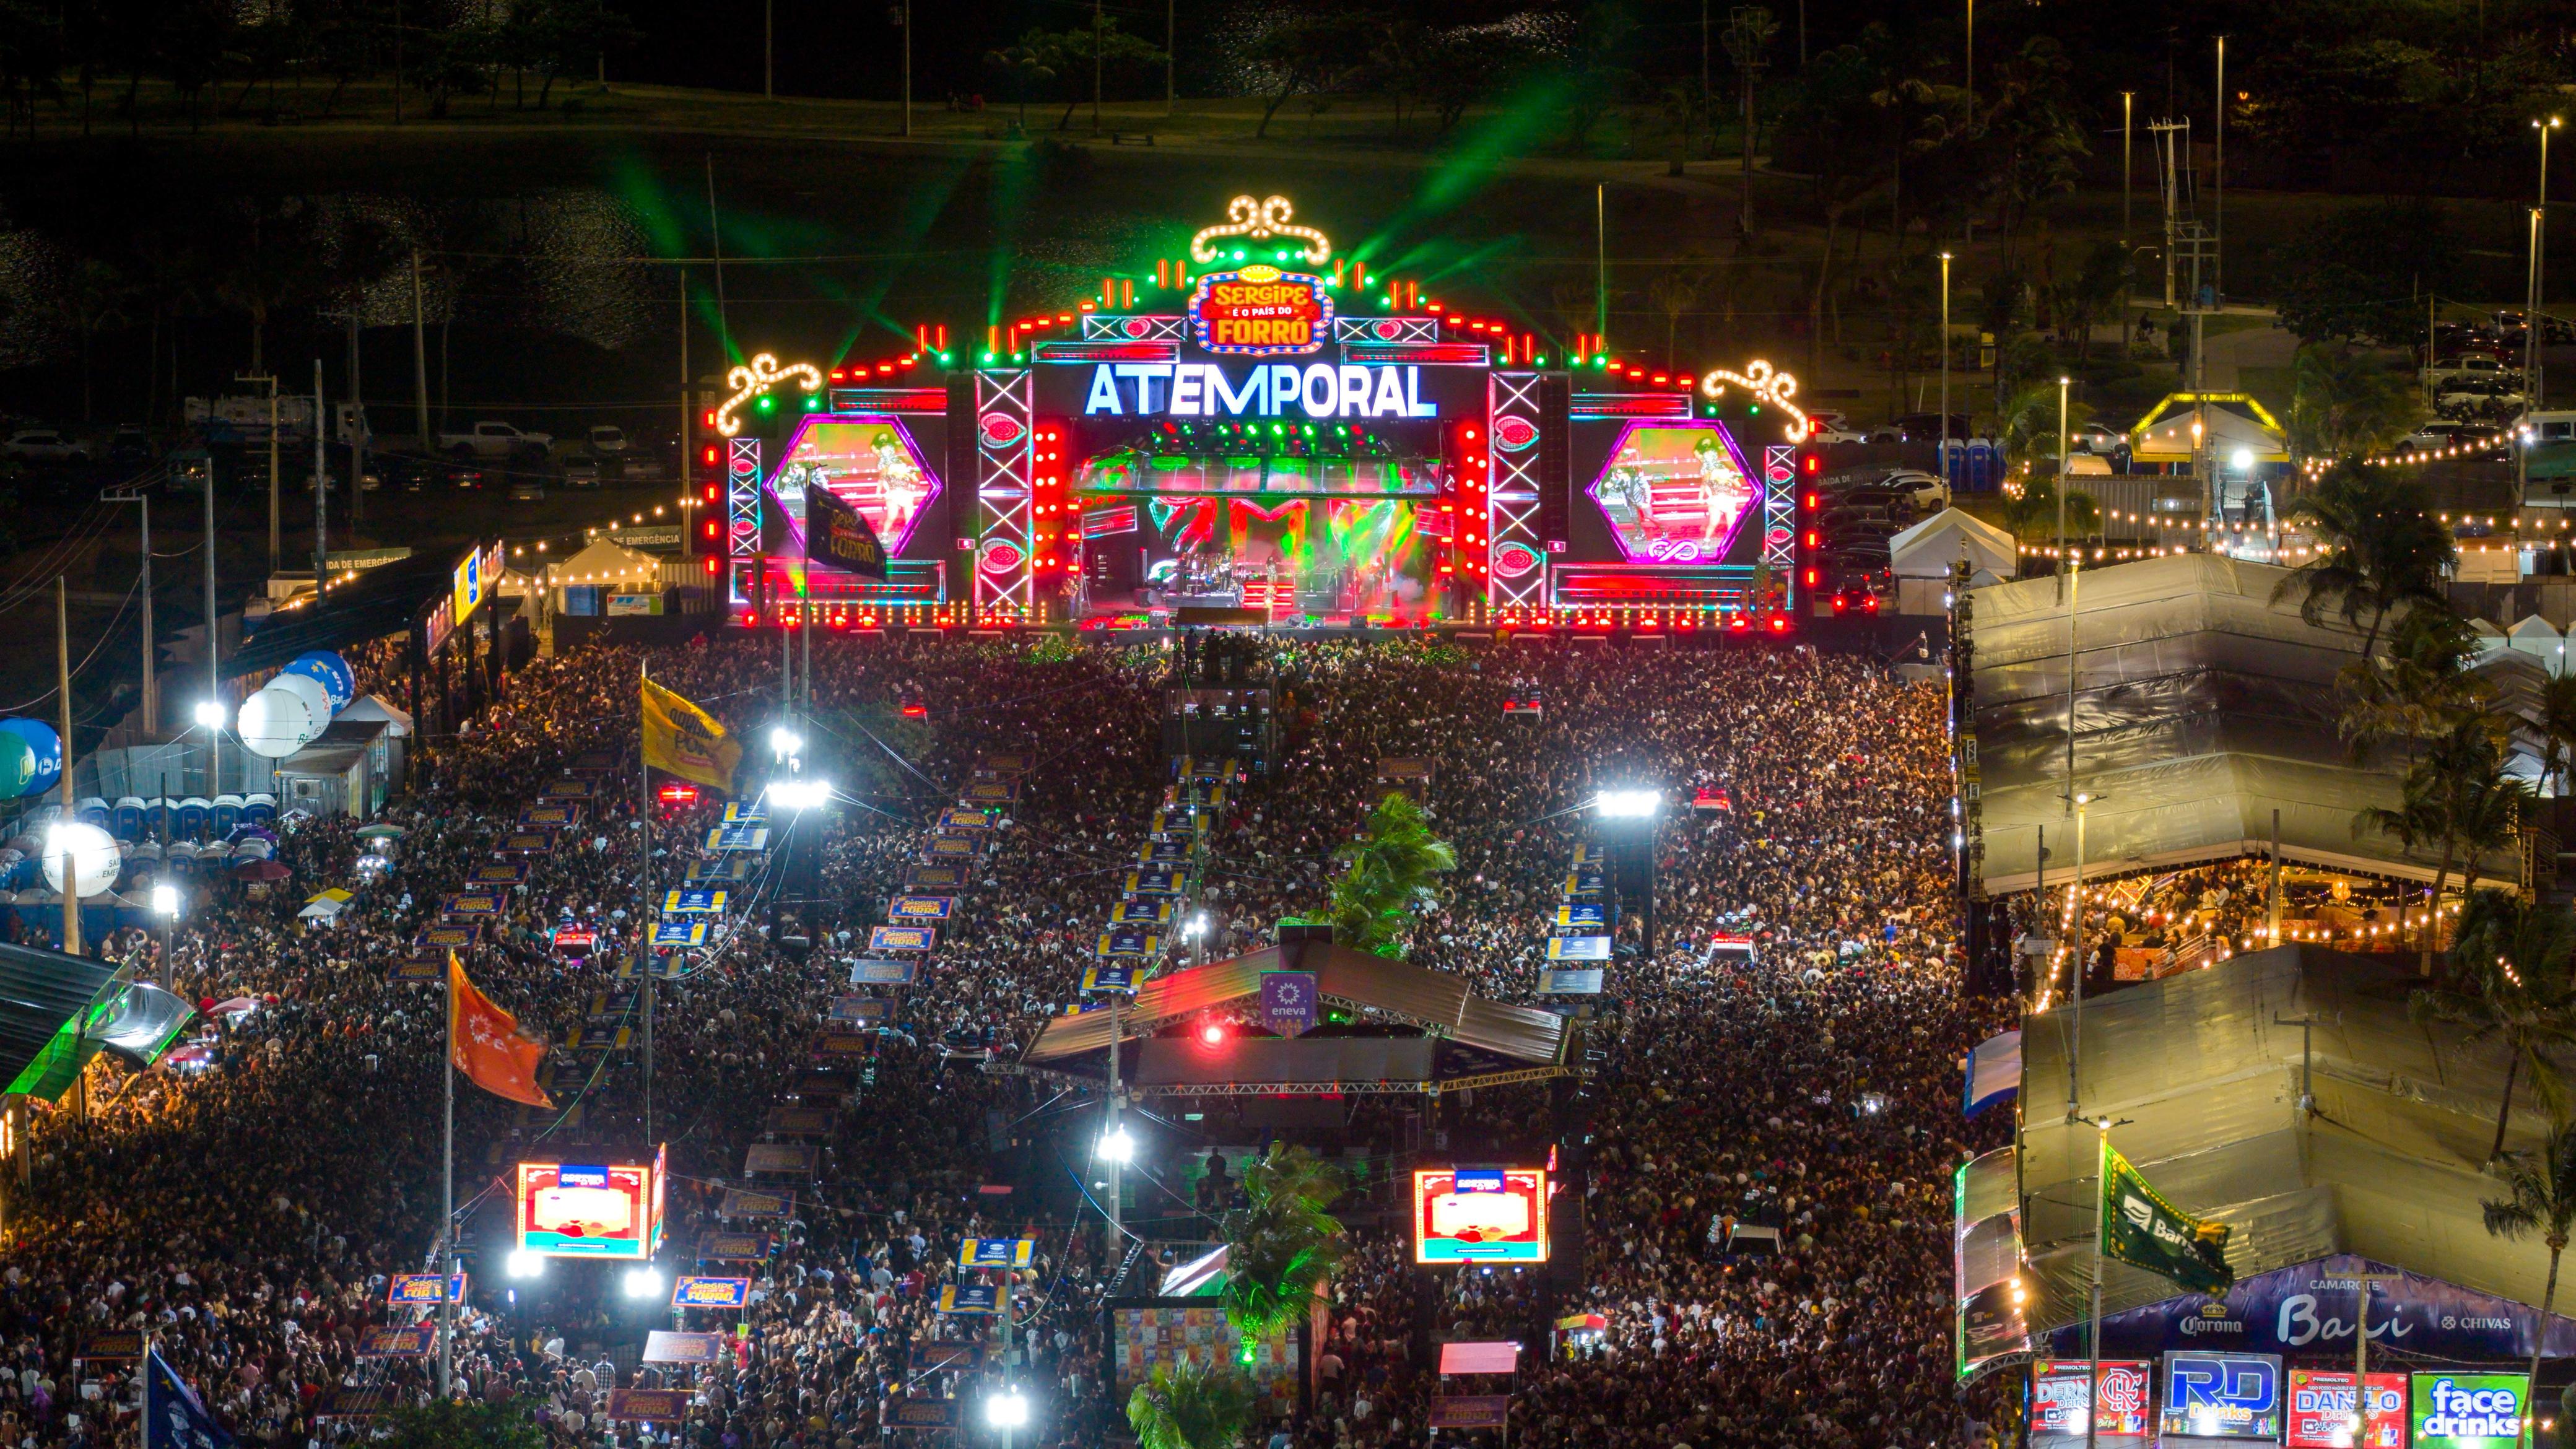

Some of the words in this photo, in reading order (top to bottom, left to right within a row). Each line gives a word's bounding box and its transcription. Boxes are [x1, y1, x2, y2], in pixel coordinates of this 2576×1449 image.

[1232, 307, 1238, 316] É
[1251, 307, 1275, 316] PAÍS
[1277, 307, 1292, 316] DO
[1217, 311, 1309, 345] FORRÓ
[1085, 363, 1437, 417] ATEMPORAL
[626, 534, 680, 546] EMERGÊNCIA
[315, 560, 340, 570] SÍDA
[341, 559, 352, 568] DE
[354, 556, 407, 568] EMERGÊN
[1271, 1006, 1306, 1016] eneva
[2179, 1315, 2242, 1336] Corona
[2460, 1317, 2511, 1329] CHIVAS
[2037, 1379, 2099, 1404] DERN
[2171, 1359, 2276, 1412] RD
[2431, 1379, 2516, 1414] face
[2296, 1390, 2401, 1413] DANLO
[2423, 1411, 2520, 1437] drinks
